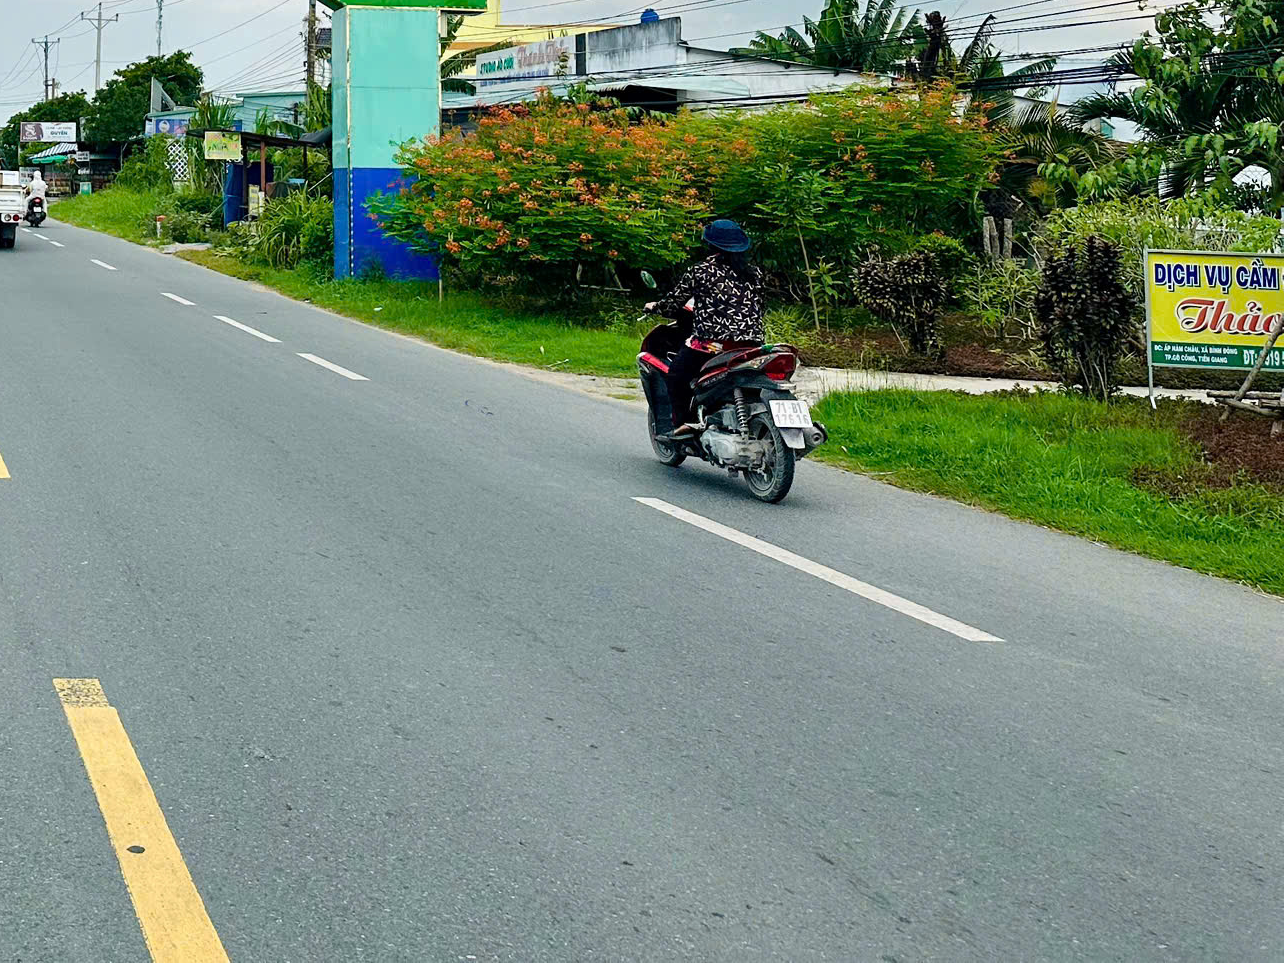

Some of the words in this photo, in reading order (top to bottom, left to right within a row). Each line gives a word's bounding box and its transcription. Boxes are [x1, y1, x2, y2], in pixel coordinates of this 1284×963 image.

[1154, 263, 1200, 291] DỊCH
[1204, 265, 1232, 293] VỤ
[1236, 258, 1279, 290] CẦM
